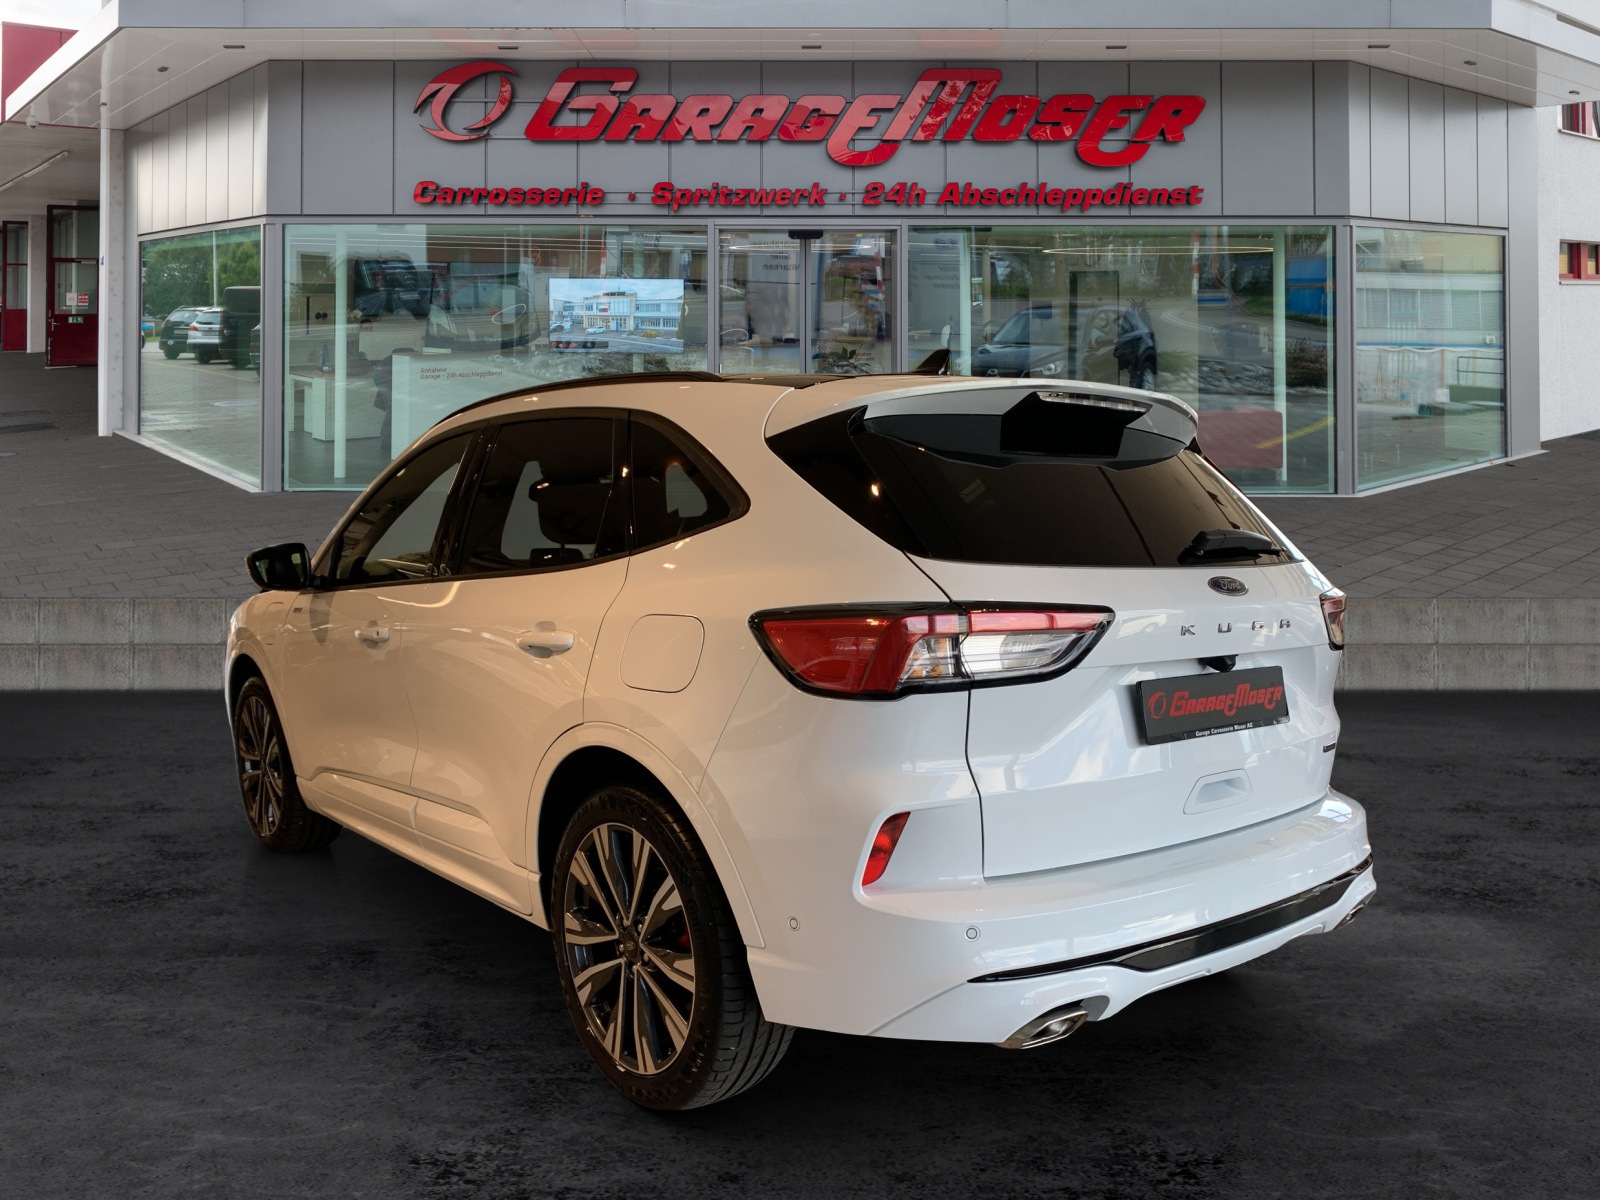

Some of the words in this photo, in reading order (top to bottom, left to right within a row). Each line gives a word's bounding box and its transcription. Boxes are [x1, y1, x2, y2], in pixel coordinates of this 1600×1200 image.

[413, 181, 605, 206] Carrosserie
[651, 181, 828, 211] Spritzwerk
[862, 182, 927, 206] 24h
[937, 182, 1205, 212] Abschleppdienst
[458, 370, 503, 378] Abschleppdienst
